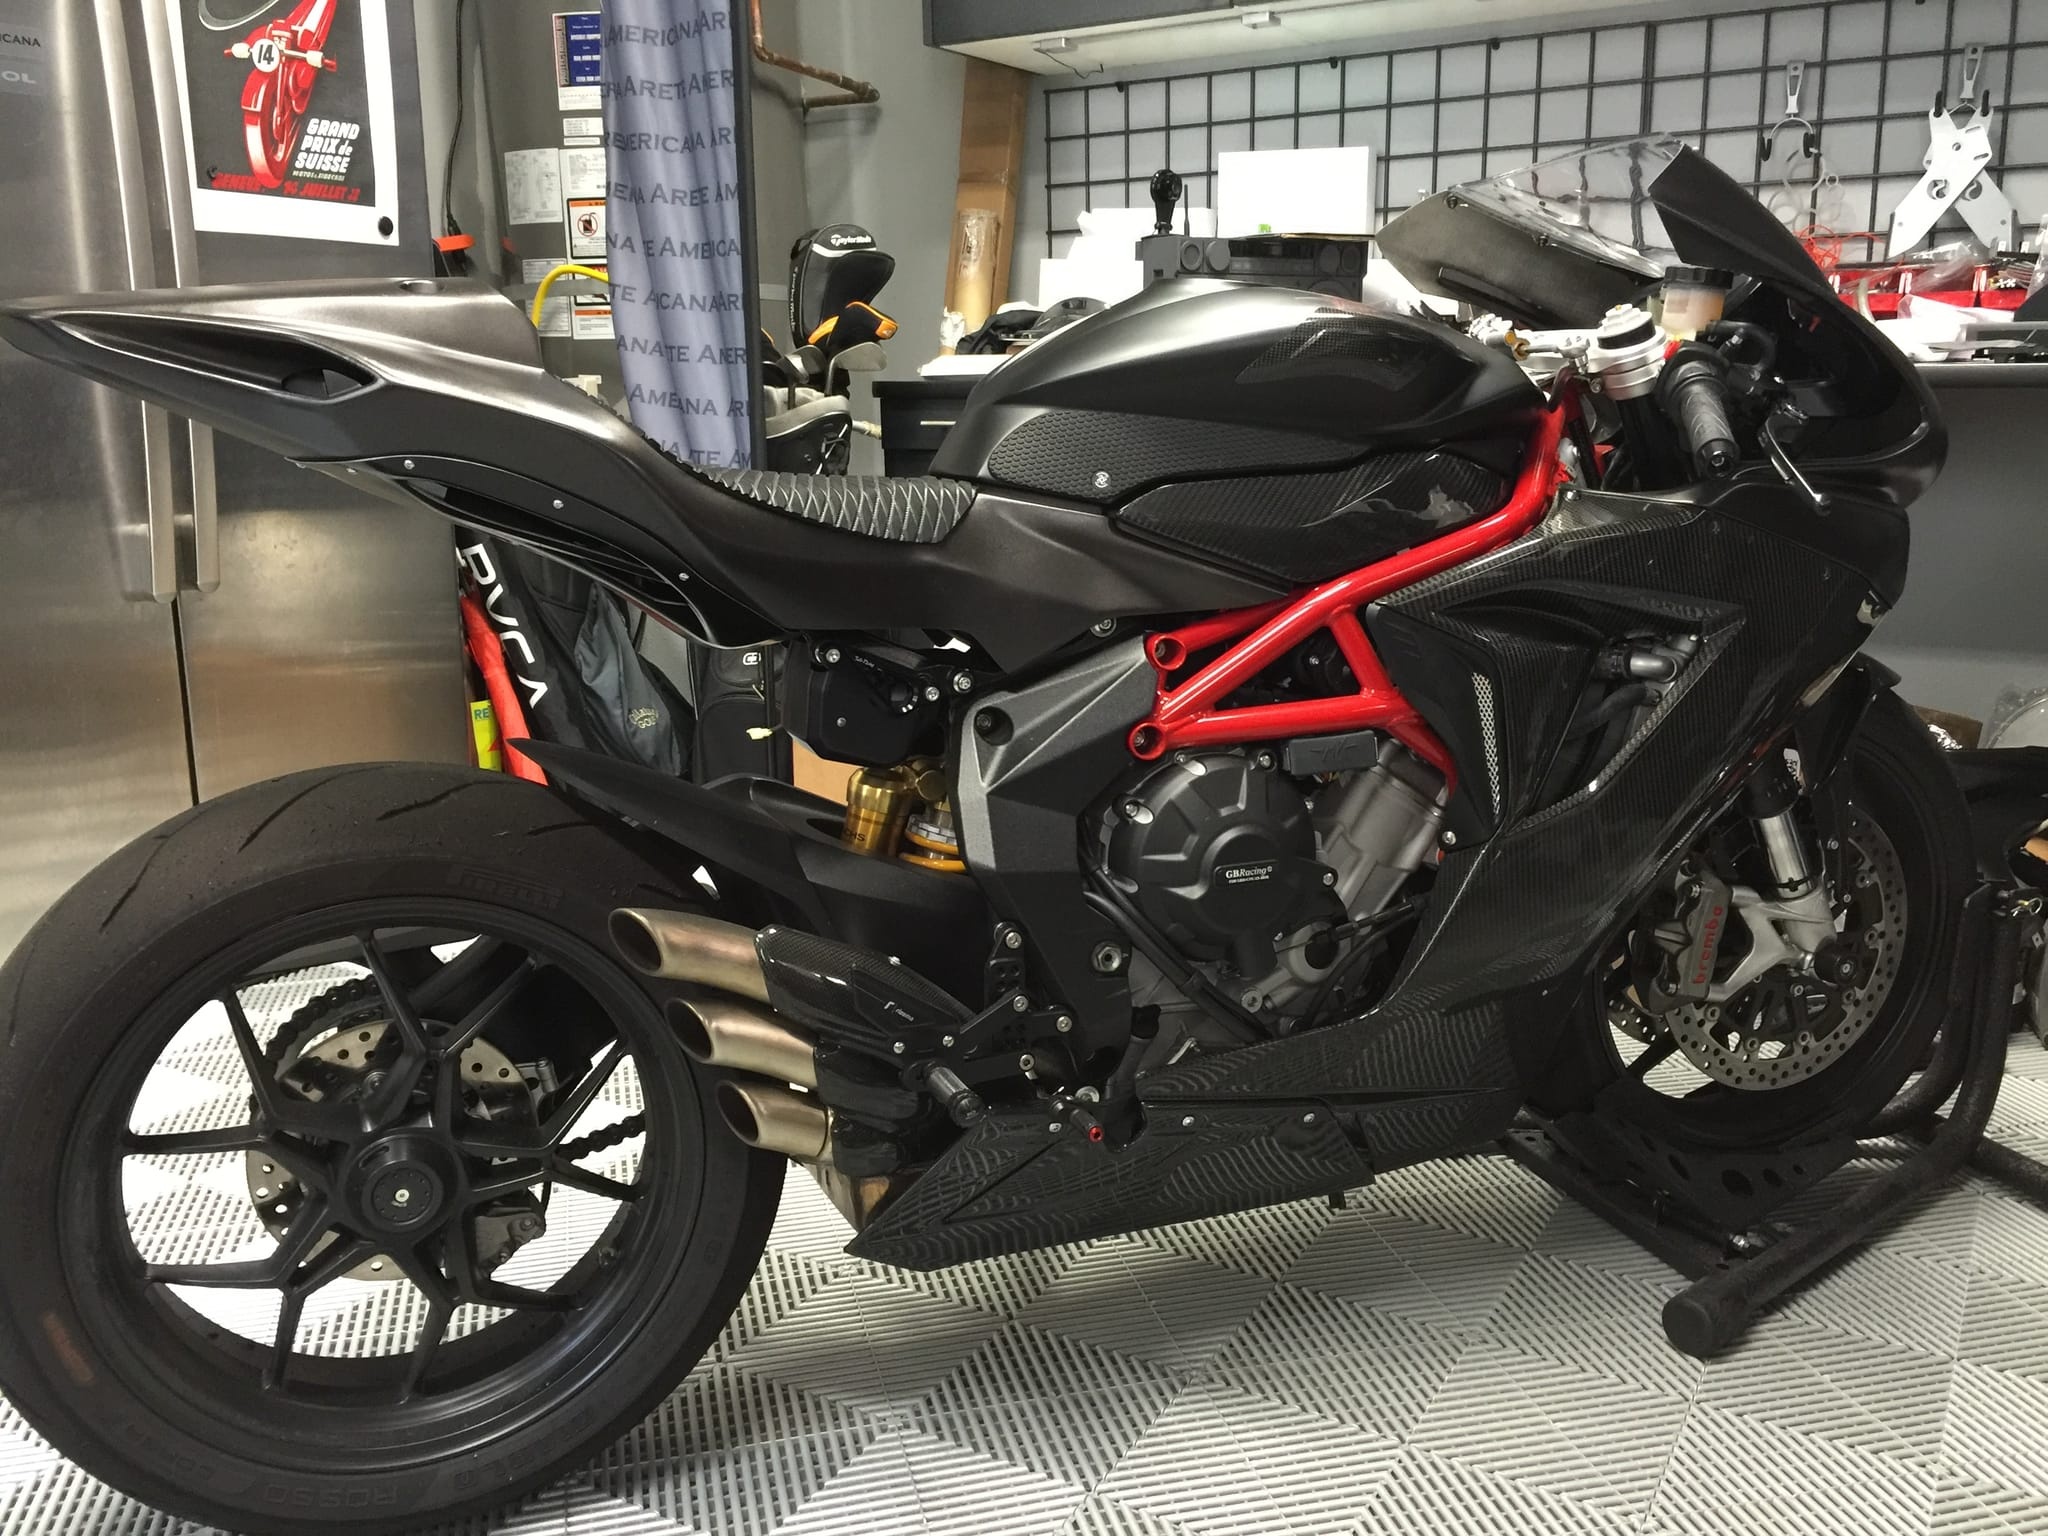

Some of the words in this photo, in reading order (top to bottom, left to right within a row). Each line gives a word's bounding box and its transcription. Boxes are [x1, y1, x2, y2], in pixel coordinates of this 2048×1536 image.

[257, 43, 275, 65] 14
[307, 118, 360, 140] GRAND
[301, 134, 341, 154] PRIX
[338, 140, 353, 156] de
[295, 152, 350, 173] SUISSE
[1691, 904, 1724, 985] brembo
